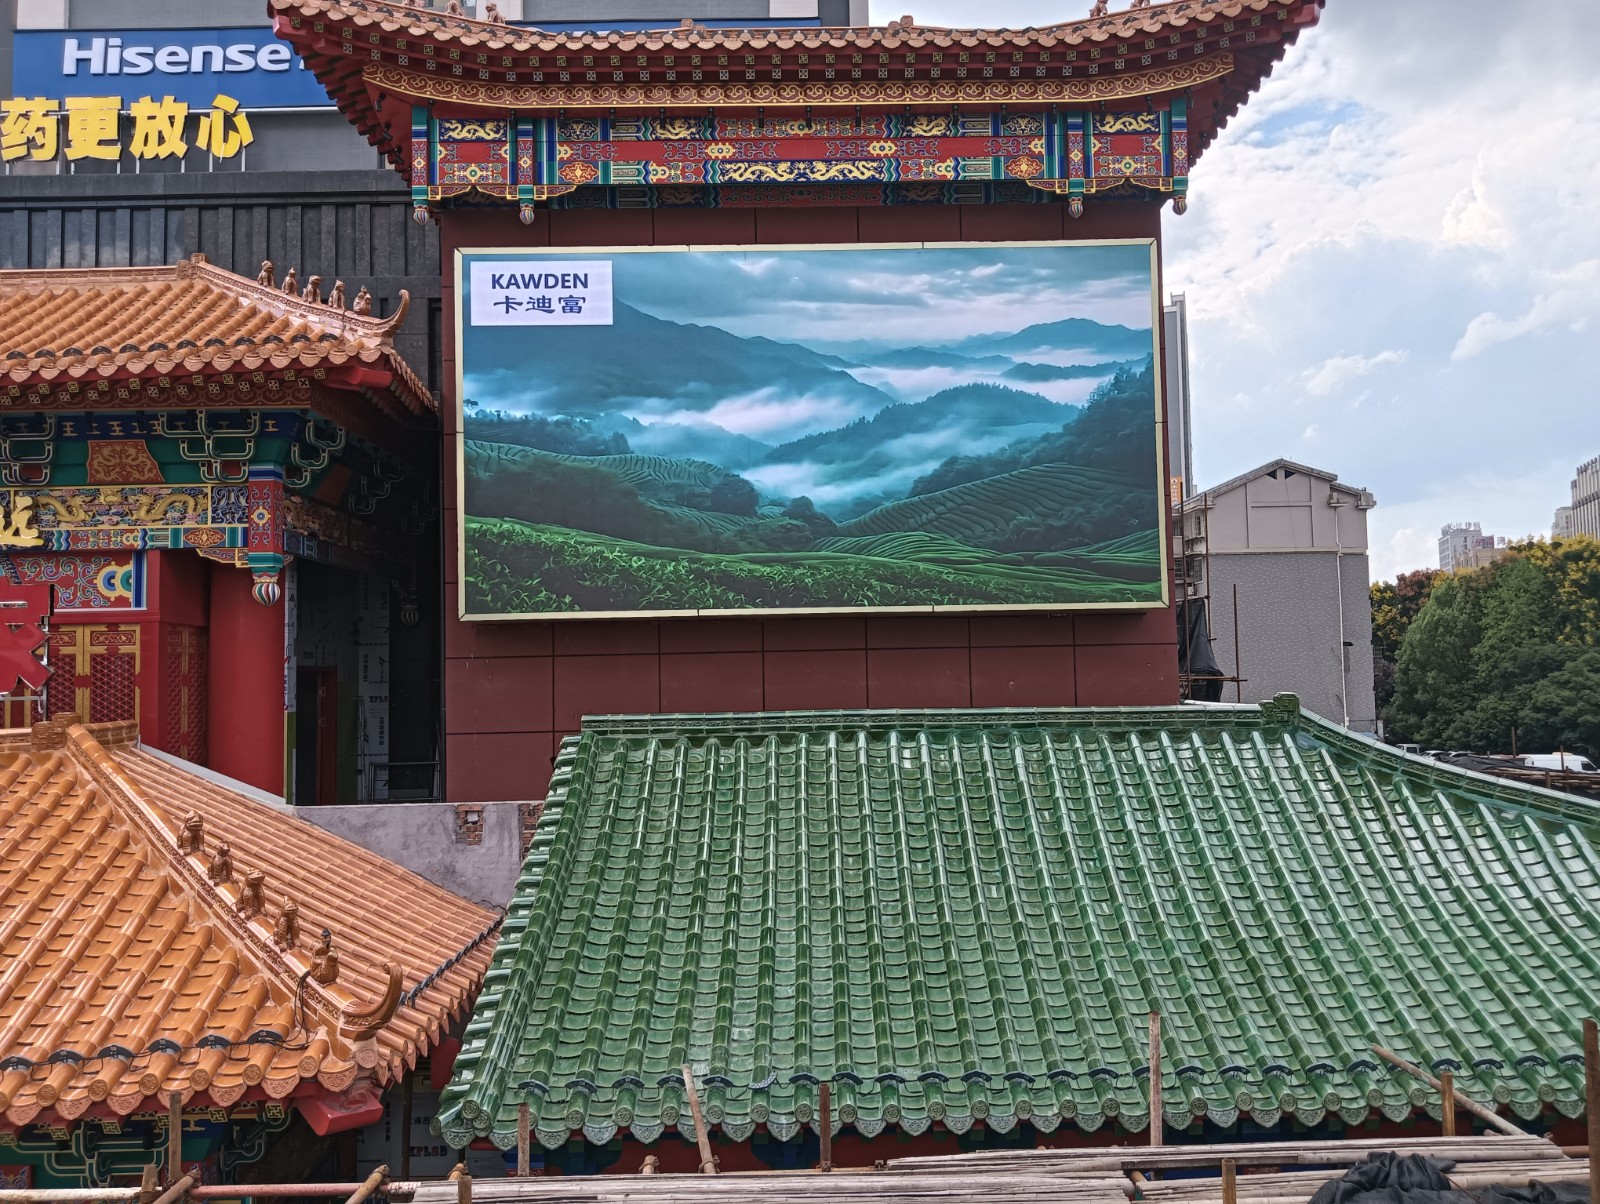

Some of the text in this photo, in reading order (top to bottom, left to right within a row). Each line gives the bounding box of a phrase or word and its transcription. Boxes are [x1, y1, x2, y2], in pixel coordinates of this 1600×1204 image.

[62, 37, 291, 75] Hisense
[0, 94, 254, 162] 药更放心
[491, 273, 589, 290] KAWDEN
[493, 294, 586, 315] 卡迪富
